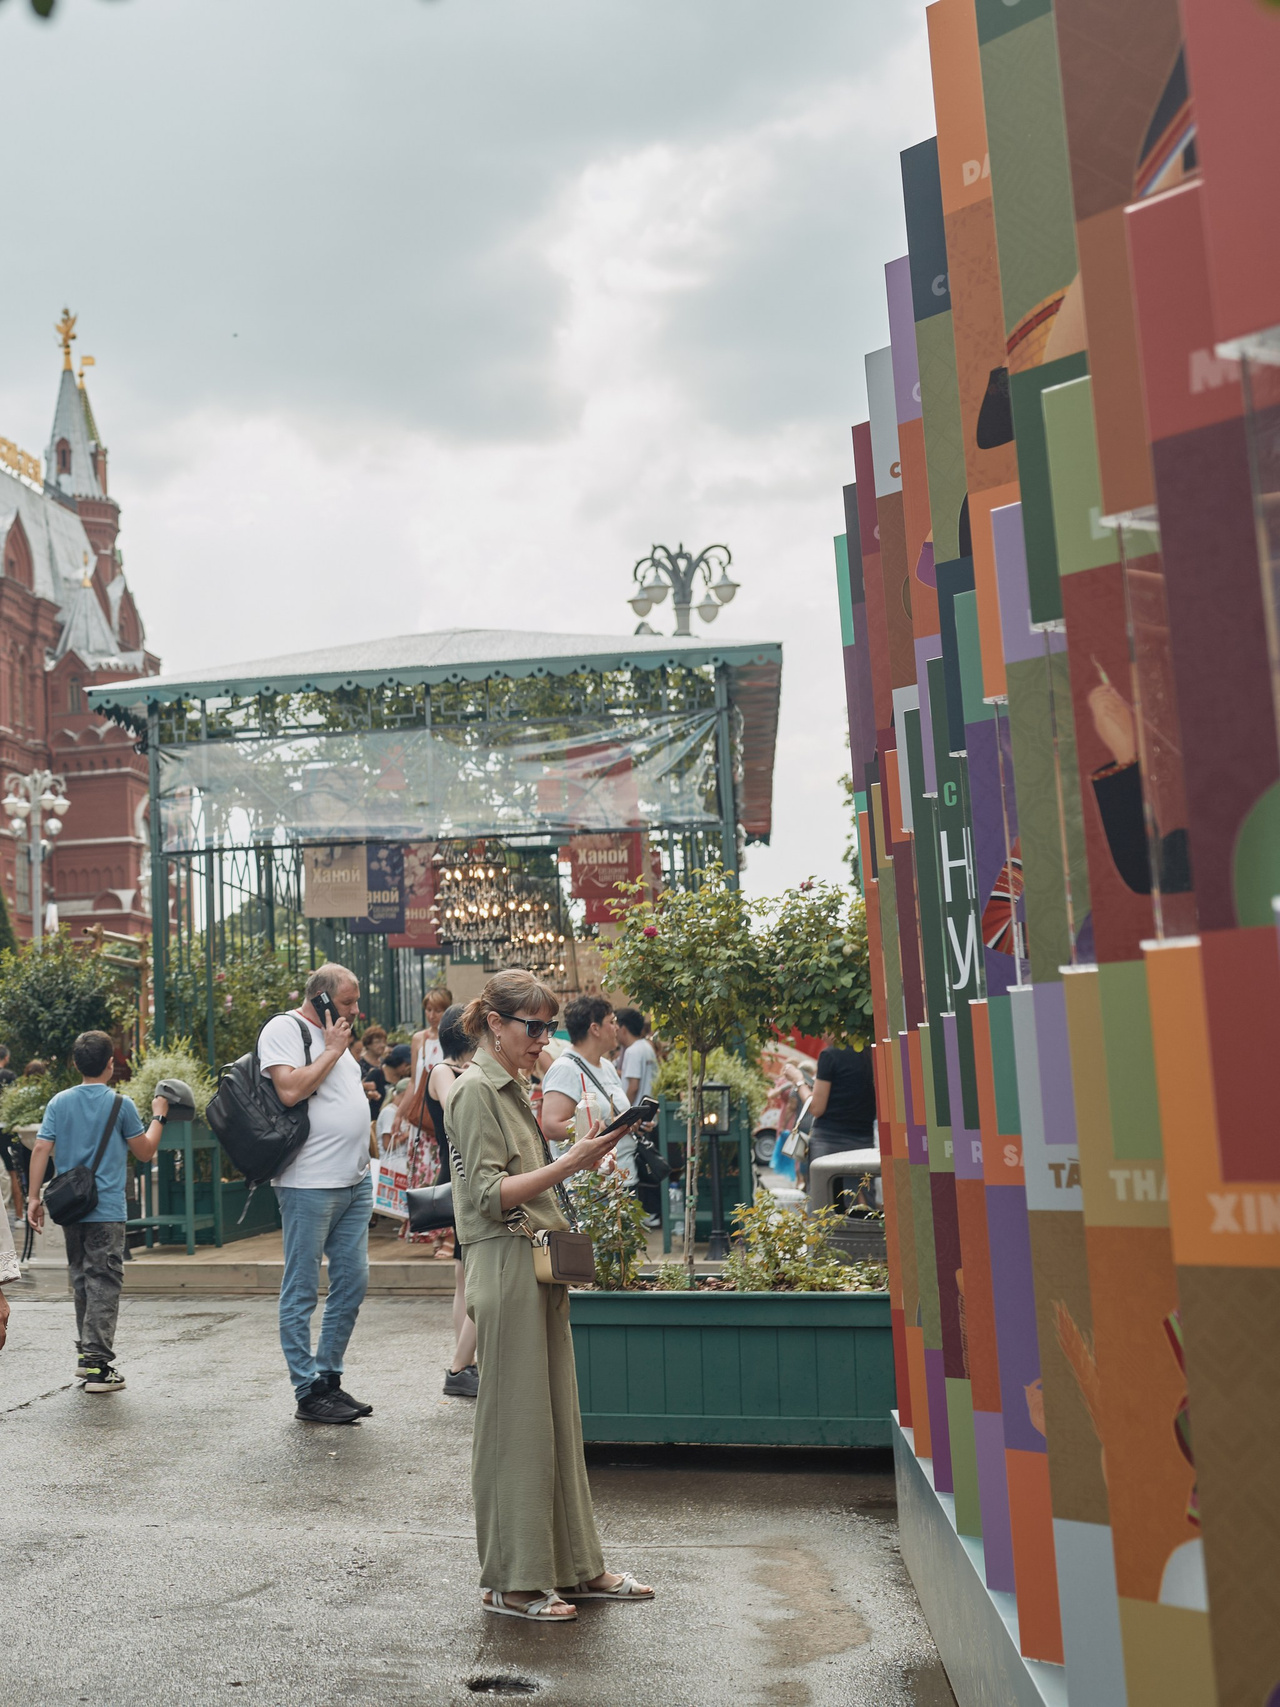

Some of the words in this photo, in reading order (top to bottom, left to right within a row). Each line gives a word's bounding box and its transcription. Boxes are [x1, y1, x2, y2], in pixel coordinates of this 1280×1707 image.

[931, 272, 950, 296] C
[577, 845, 629, 865] Ханой
[312, 865, 361, 883] Ханой
[367, 886, 400, 903] аной
[1003, 1144, 1024, 1167] S
